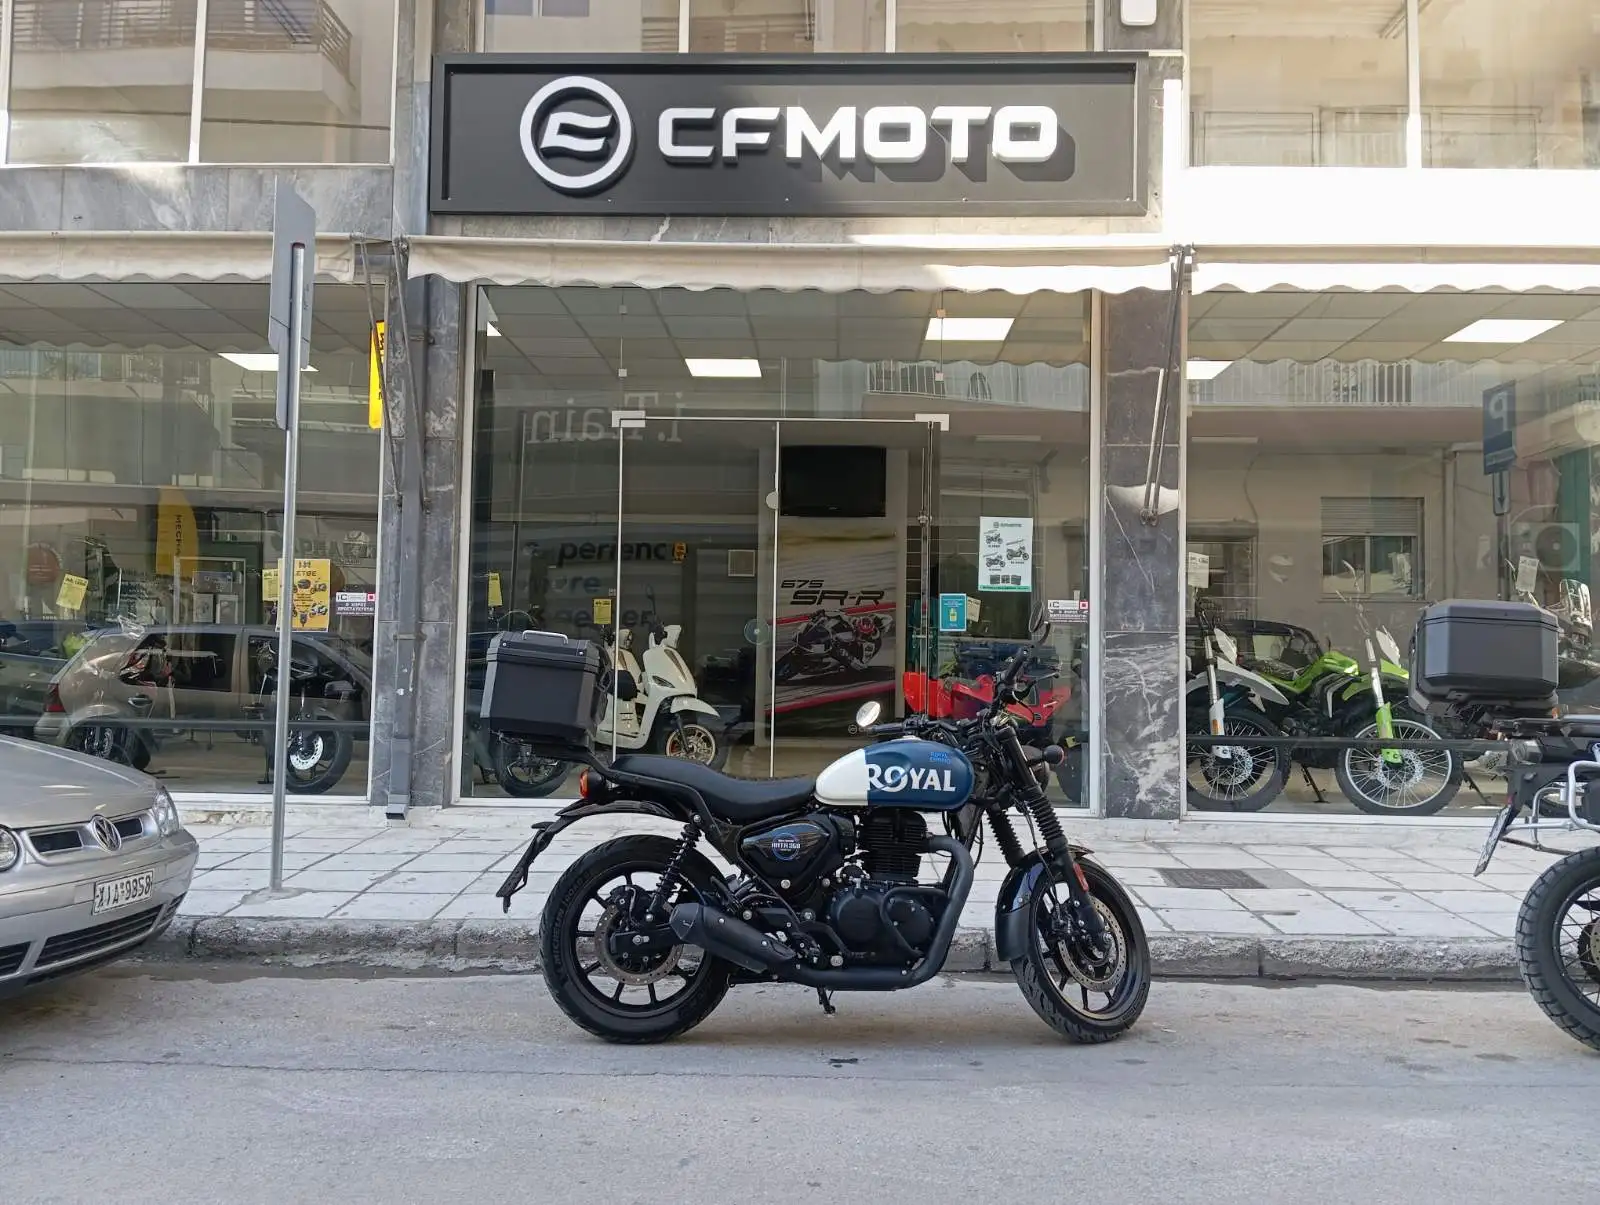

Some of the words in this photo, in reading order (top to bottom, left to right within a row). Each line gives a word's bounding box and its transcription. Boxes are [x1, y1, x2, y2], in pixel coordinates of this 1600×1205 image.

[658, 106, 1058, 164] CFMOTO
[781, 580, 825, 589] 675
[790, 590, 885, 606] SR-R
[865, 763, 957, 793] ROYAL
